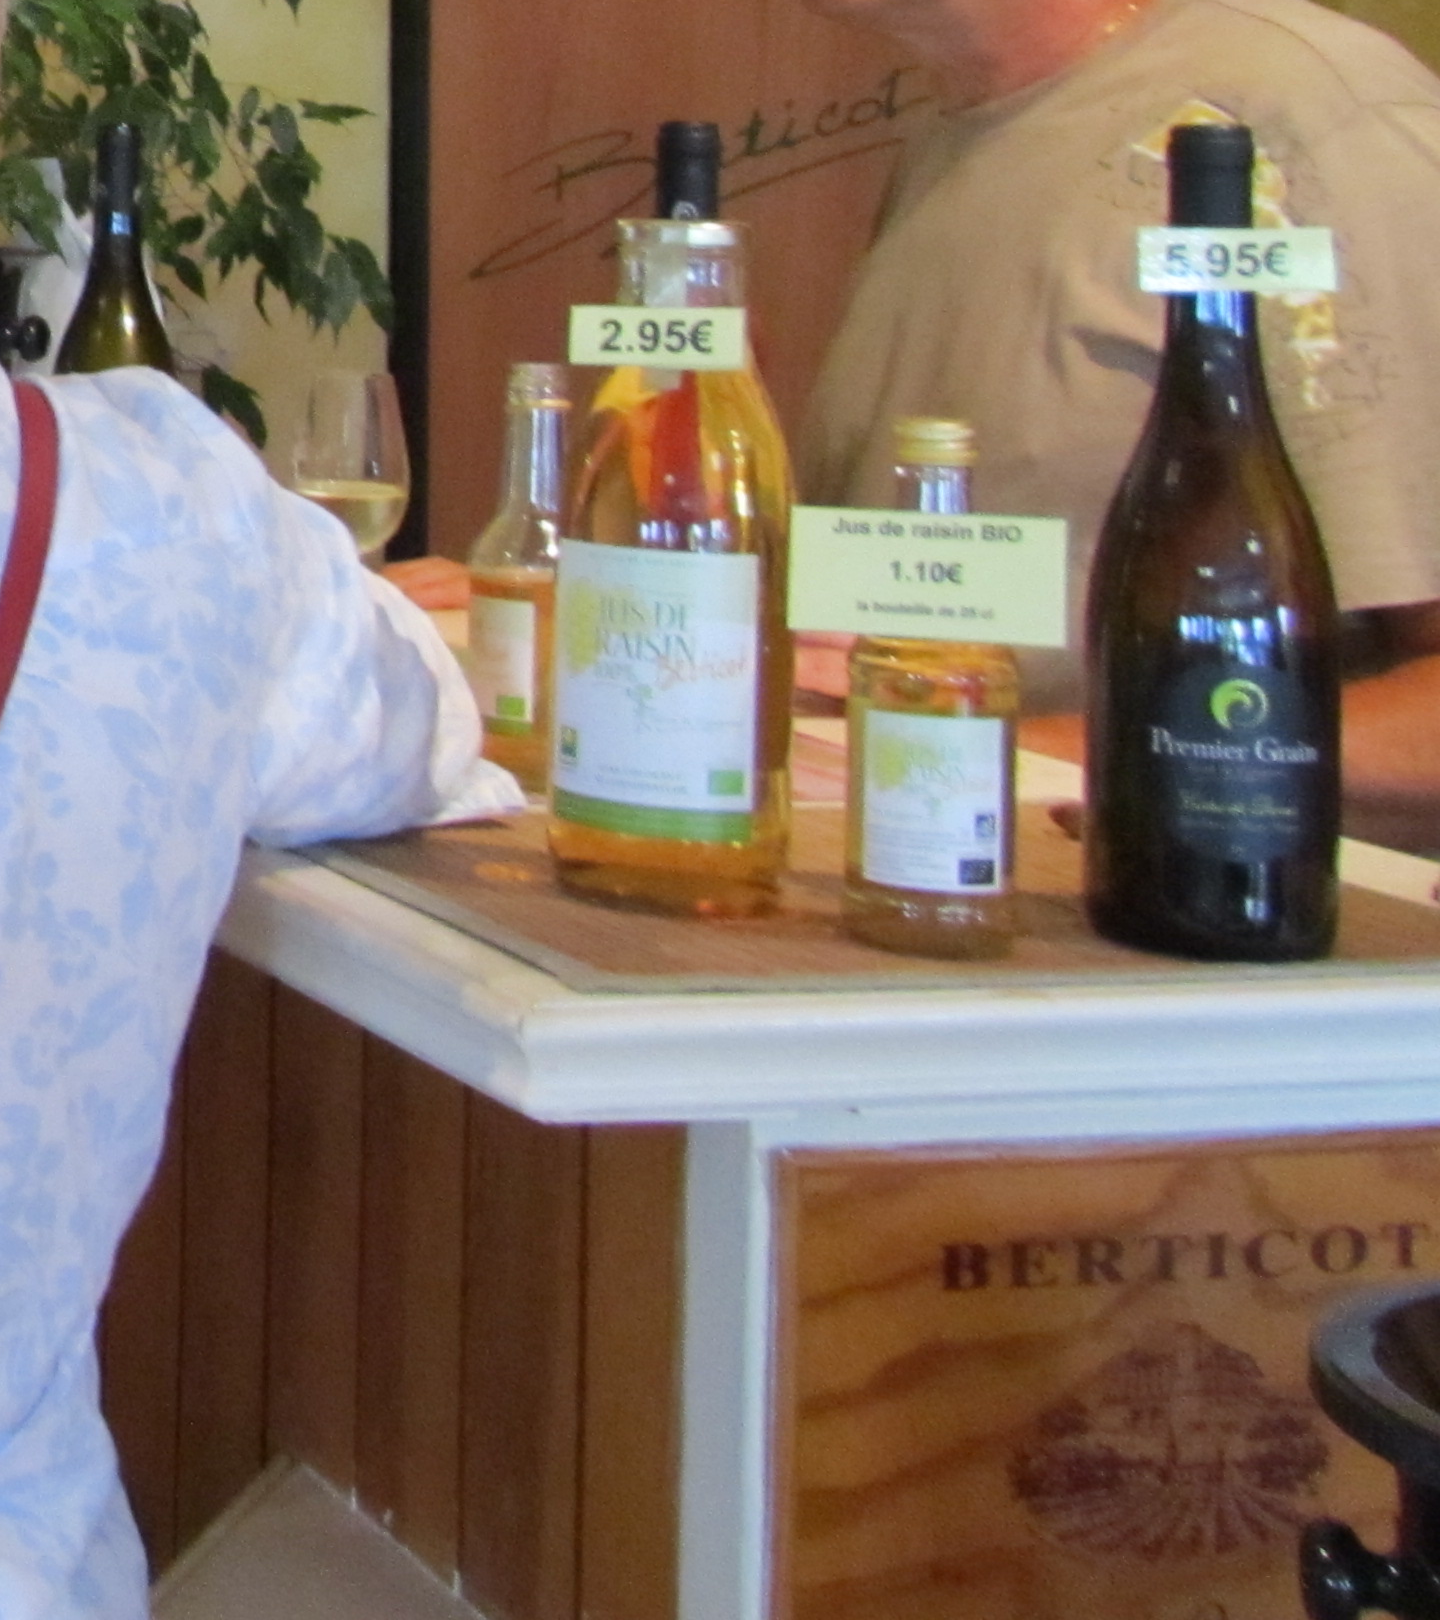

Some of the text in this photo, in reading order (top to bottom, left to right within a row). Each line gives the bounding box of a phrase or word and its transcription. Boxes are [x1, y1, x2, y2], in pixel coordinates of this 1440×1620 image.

[1165, 242, 1289, 277] 5.95€
[600, 319, 713, 353] 2.95€
[832, 517, 1023, 543] Jus de raisin BIO
[890, 560, 963, 584] 1.10€
[1151, 726, 1249, 762] Premier
[939, 1222, 1428, 1290] BERTICOT
